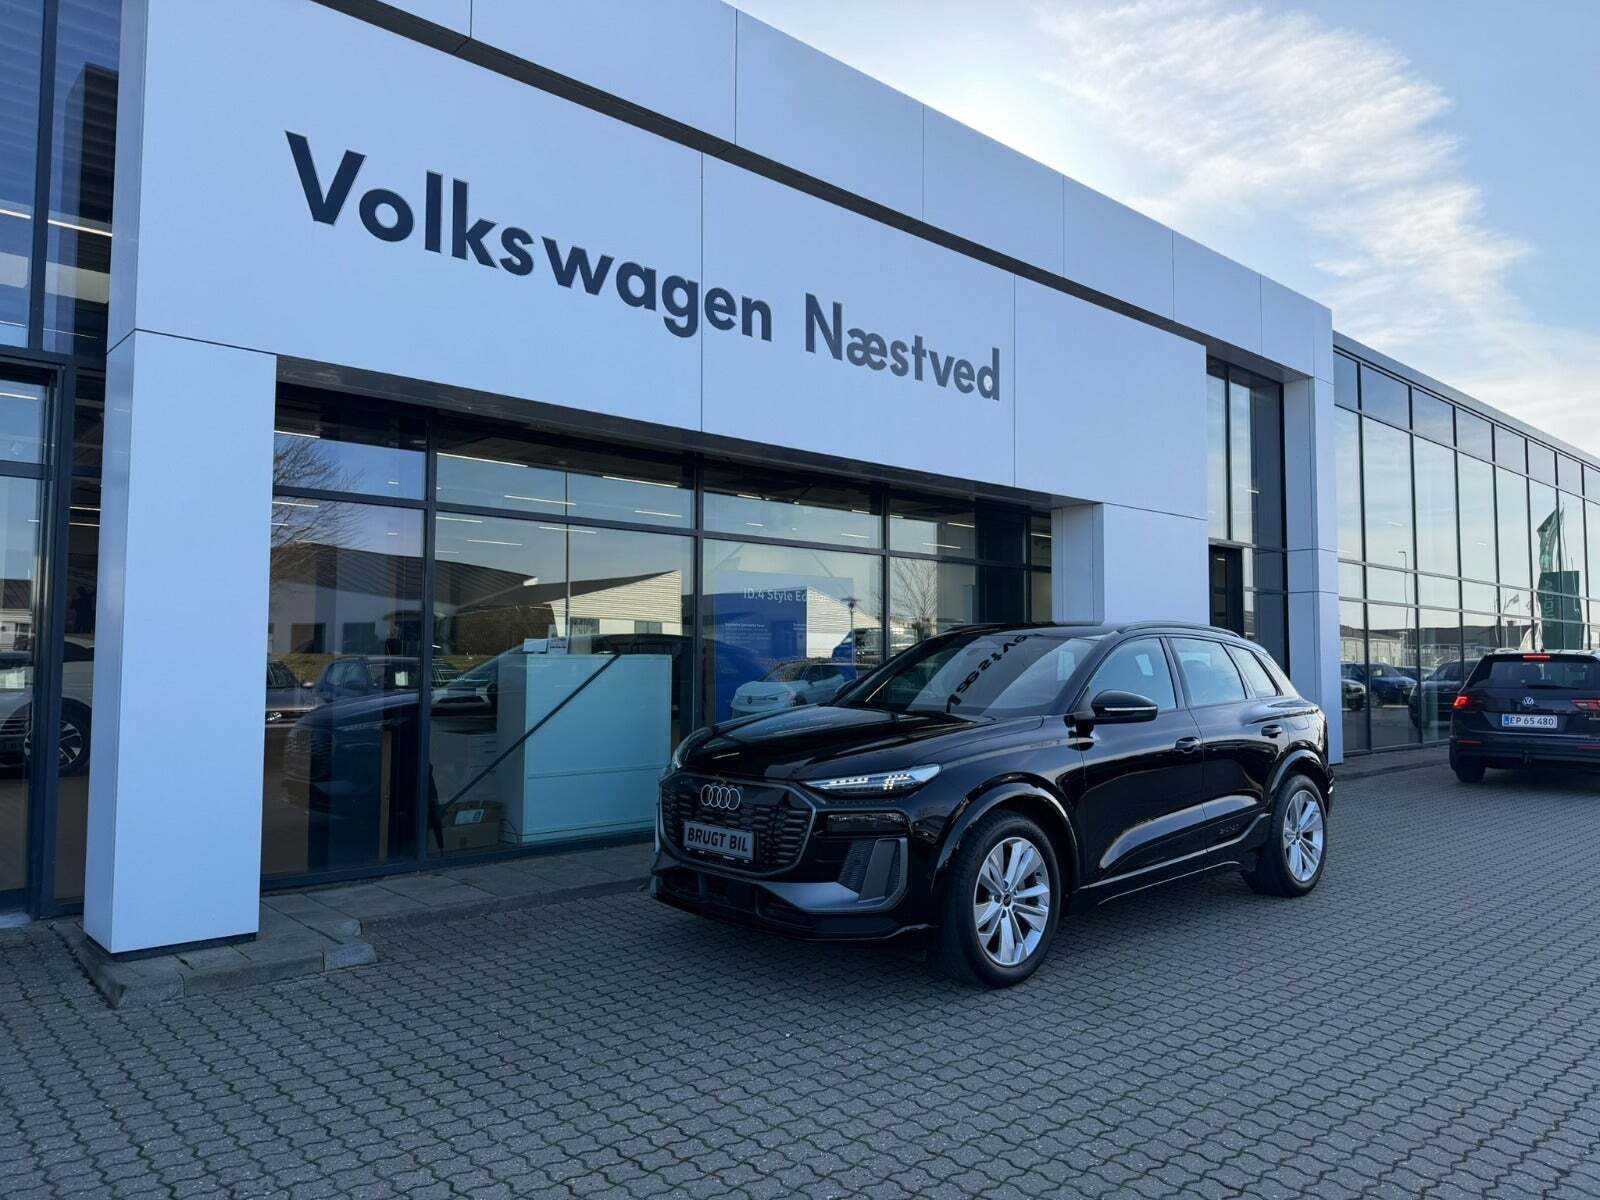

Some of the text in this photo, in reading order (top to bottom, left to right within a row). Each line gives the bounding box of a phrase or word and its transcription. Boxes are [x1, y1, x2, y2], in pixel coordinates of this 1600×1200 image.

[285, 130, 1000, 401] Volkswagen Næstved
[743, 587, 764, 600] ID.4
[767, 589, 793, 604] Style
[1510, 716, 1555, 726] EP 65 480
[687, 827, 748, 852] BRUGT BIL
